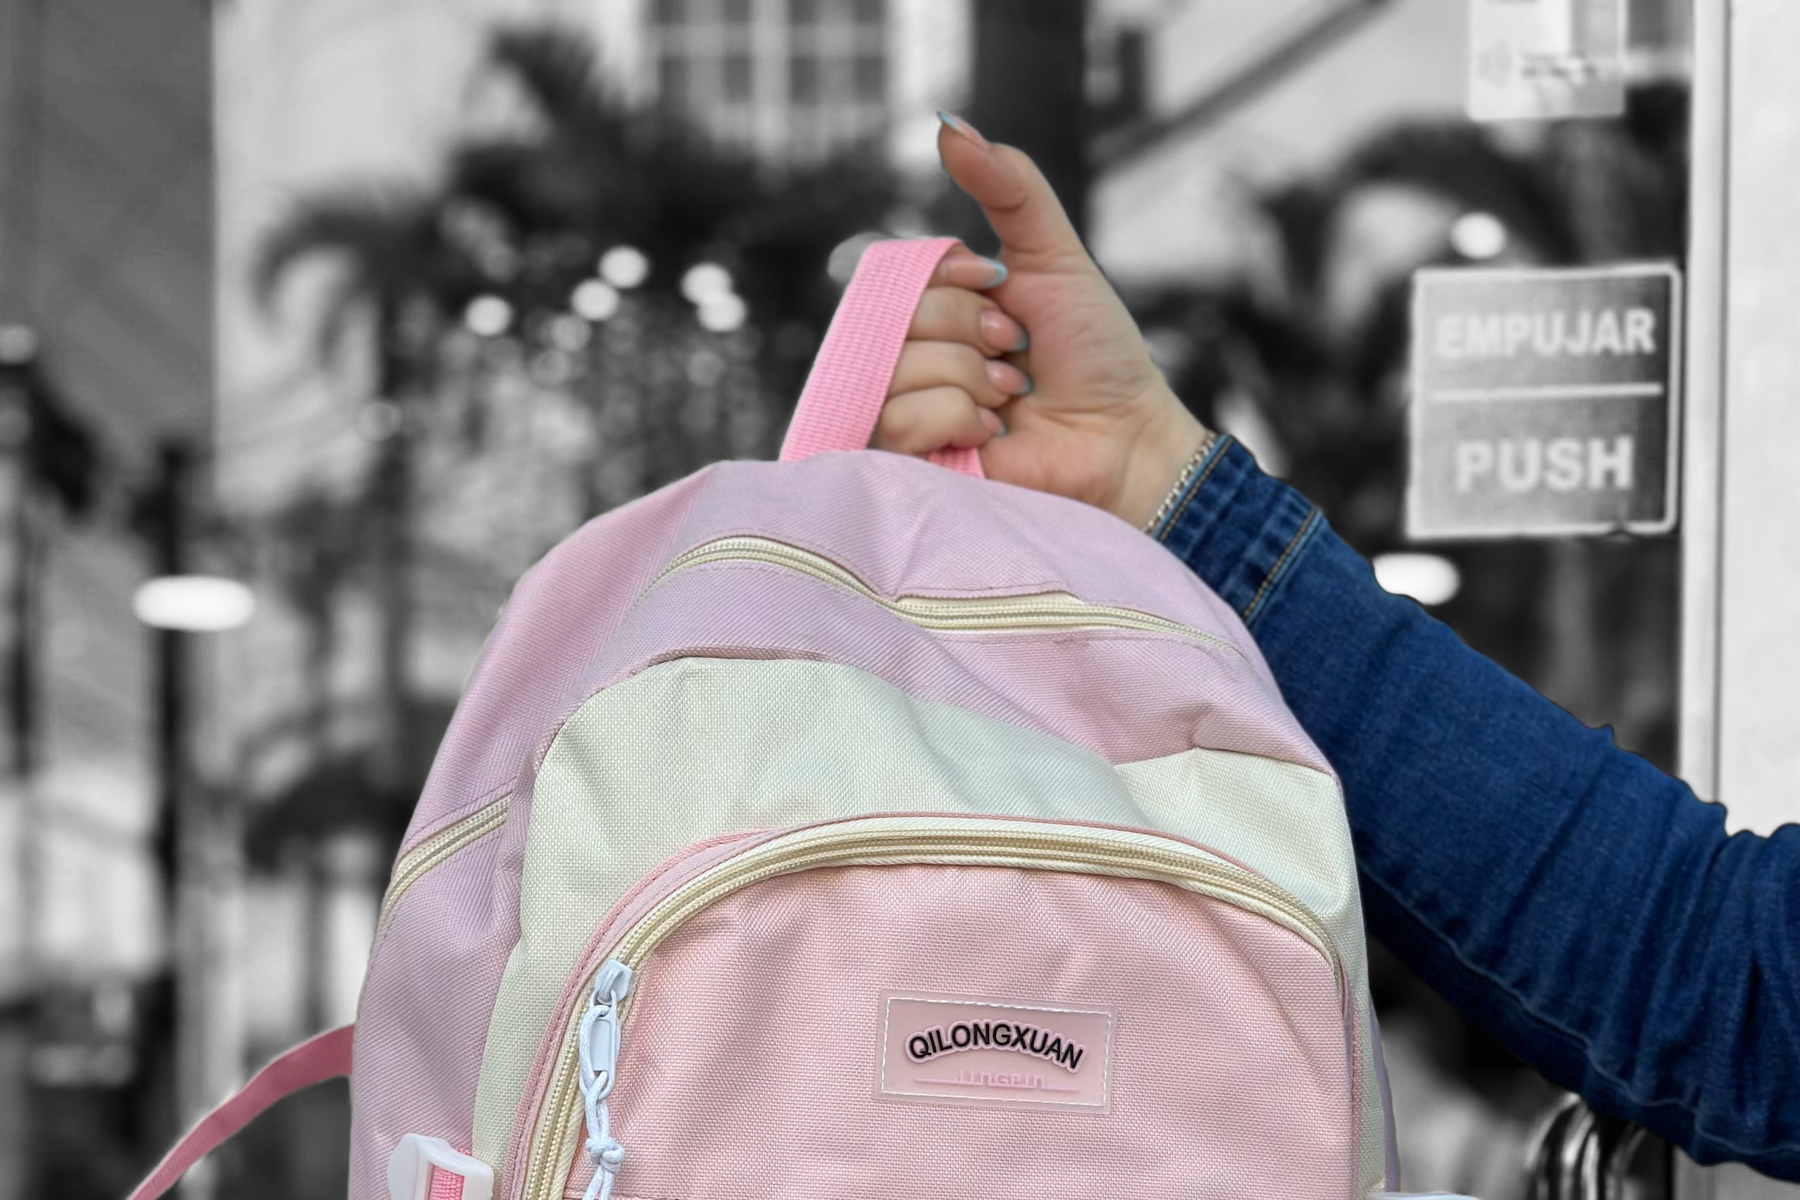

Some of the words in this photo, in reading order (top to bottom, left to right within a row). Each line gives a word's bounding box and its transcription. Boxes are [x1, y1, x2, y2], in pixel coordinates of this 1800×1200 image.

[1436, 307, 1657, 358] EMPUJAR
[1456, 435, 1636, 494] PUSH
[908, 1022, 1084, 1070] QILONGXUAN
